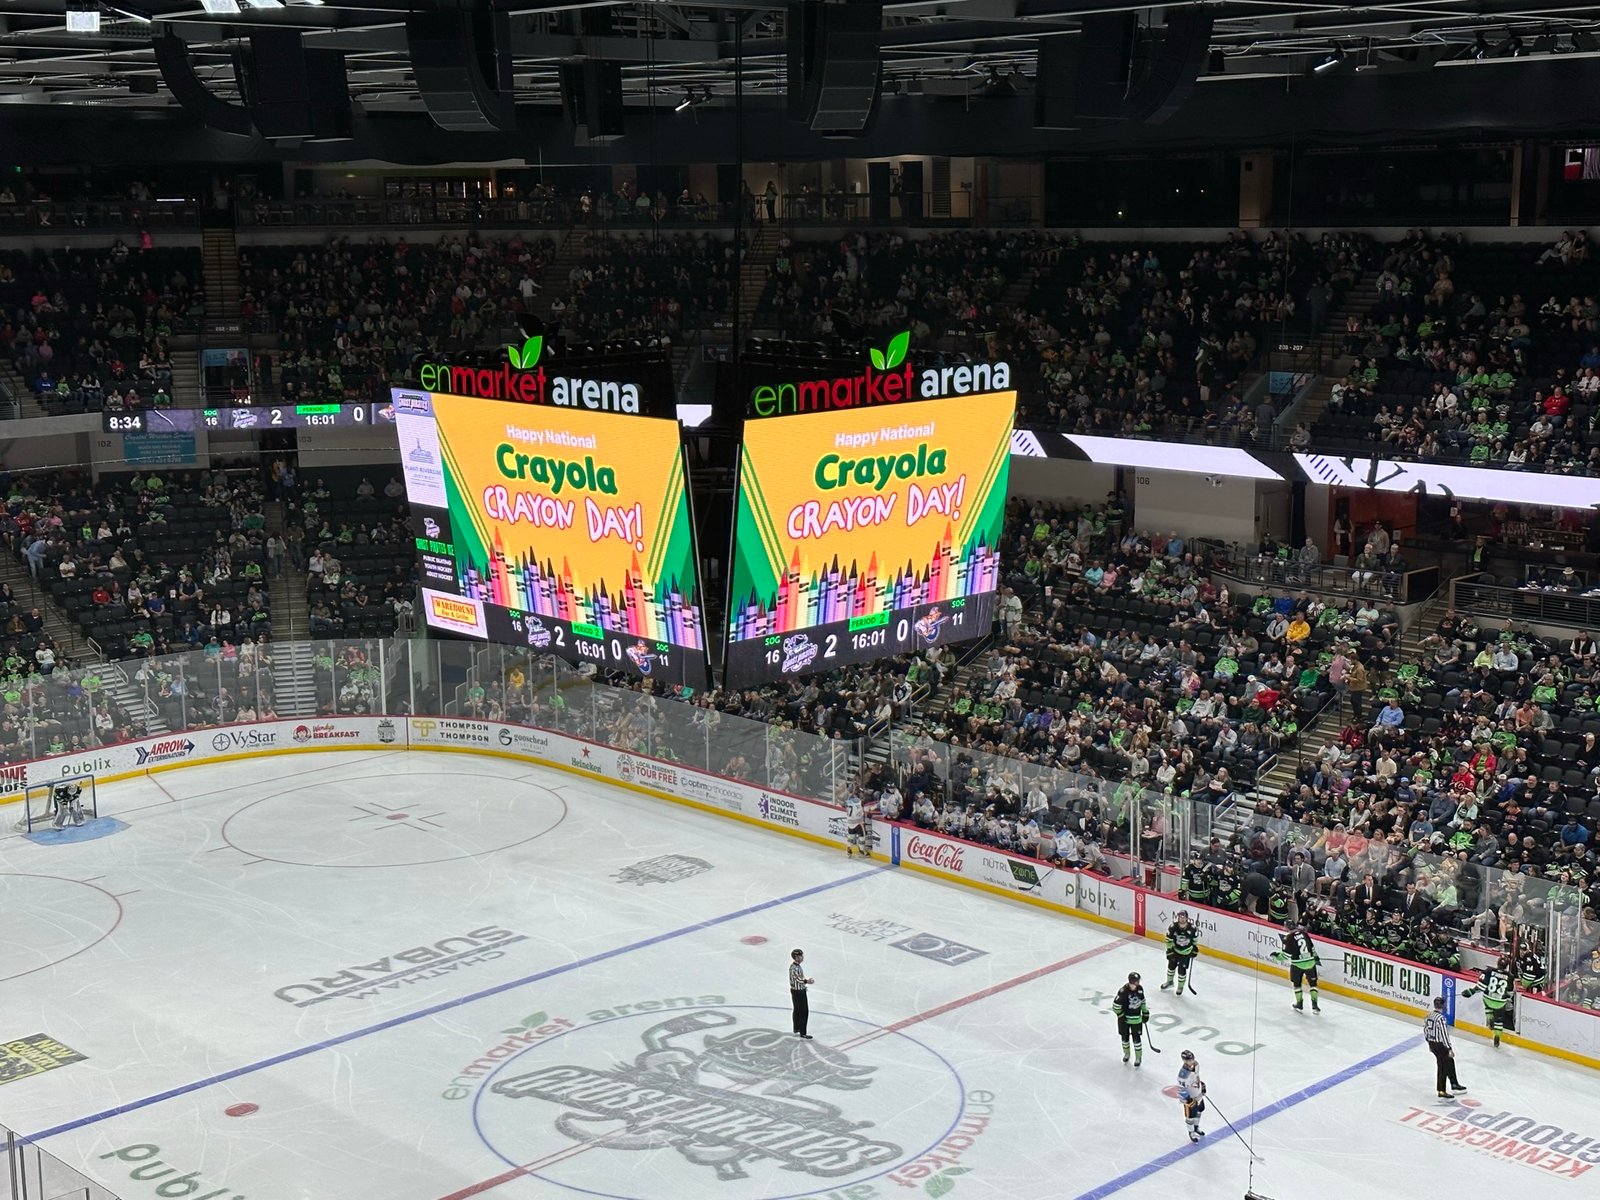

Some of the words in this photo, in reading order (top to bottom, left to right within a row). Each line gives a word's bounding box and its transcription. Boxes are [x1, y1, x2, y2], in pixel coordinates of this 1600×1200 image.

[420, 362, 546, 403] enmarket
[552, 376, 639, 413] arena
[754, 362, 915, 416] enmarket
[920, 362, 1010, 398] arena
[205, 417, 218, 426] 16
[271, 409, 282, 425] 2
[305, 414, 335, 425] 16:01
[353, 406, 364, 422] 0
[109, 416, 141, 429] 8:34
[506, 424, 544, 446] Happy
[546, 430, 596, 450] National
[834, 430, 877, 447] Happy
[879, 421, 935, 442] National
[496, 443, 618, 495] Crayola
[814, 443, 948, 491] Crayola
[1136, 476, 1150, 485] 106
[787, 492, 898, 539] CRAYON
[906, 473, 967, 527] DAY!
[483, 485, 575, 530] CRAYON
[585, 497, 645, 553] DAY!
[435, 599, 475, 615] WAREHOUSE
[951, 599, 966, 608] SOG
[511, 620, 522, 632] 16
[851, 617, 876, 628] PERIOD
[878, 613, 886, 624] 2
[951, 612, 964, 626] 11
[554, 625, 566, 647] 2
[574, 624, 593, 635] PERIOD
[594, 627, 600, 637] 2
[896, 619, 909, 641] 0
[656, 643, 669, 652] SOG
[764, 635, 781, 646] SOG
[823, 634, 838, 658] 2
[851, 629, 886, 650] 16:01
[574, 639, 606, 660] 16:01
[611, 639, 622, 660] 0
[765, 649, 780, 664] 16
[658, 654, 669, 667] 11
[440, 721, 489, 731] THOMPSON
[230, 730, 276, 748] VyStar
[313, 731, 360, 739] BREAKFAST
[440, 732, 489, 742] THOMPSON
[513, 734, 548, 746] goosehead
[149, 739, 186, 755] ARROW
[571, 757, 602, 773] Heineken
[636, 761, 651, 770] LOCAL
[651, 765, 677, 776] RESIDENTS
[635, 766, 657, 780] TOUR
[658, 772, 678, 786] FREE
[769, 797, 795, 810] INDOOR
[769, 805, 798, 818] CLIMATE
[770, 813, 799, 826] EXPERTS
[273, 925, 513, 1003] SUBARU
[348, 950, 506, 1000] CHATHAM
[1343, 952, 1394, 987] FANTOM
[1399, 967, 1431, 997] CLUB
[1343, 977, 1369, 990] Purchase
[1369, 985, 1391, 996] Season
[1391, 990, 1411, 1002] Tickets
[1412, 997, 1431, 1009] Today
[586, 995, 726, 1021] arena
[441, 1016, 575, 1101] enmarket
[1400, 1106, 1594, 1179] KENNICKELL
